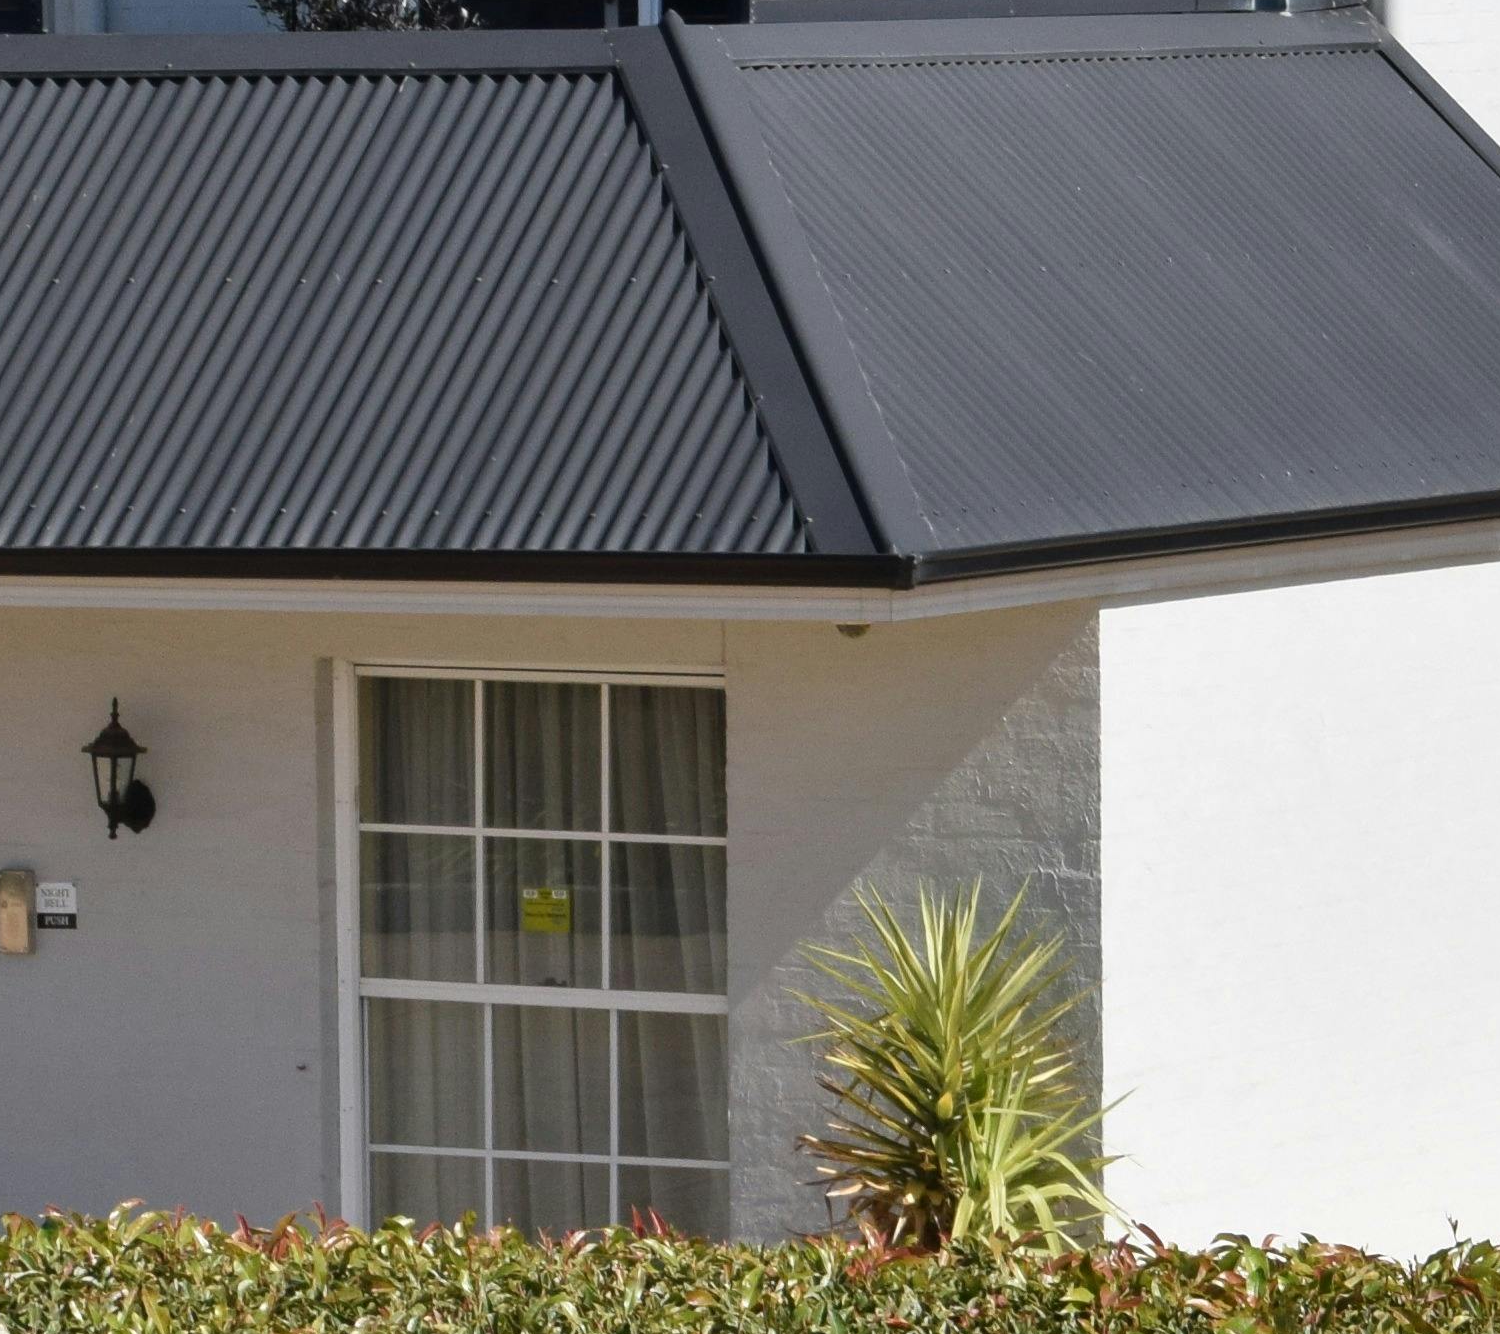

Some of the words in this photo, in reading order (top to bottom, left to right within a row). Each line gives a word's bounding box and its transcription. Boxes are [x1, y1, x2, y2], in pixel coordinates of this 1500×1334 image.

[40, 888, 70, 898] NIGHT
[44, 898, 68, 908] BELL
[44, 915, 69, 926] PUSH
